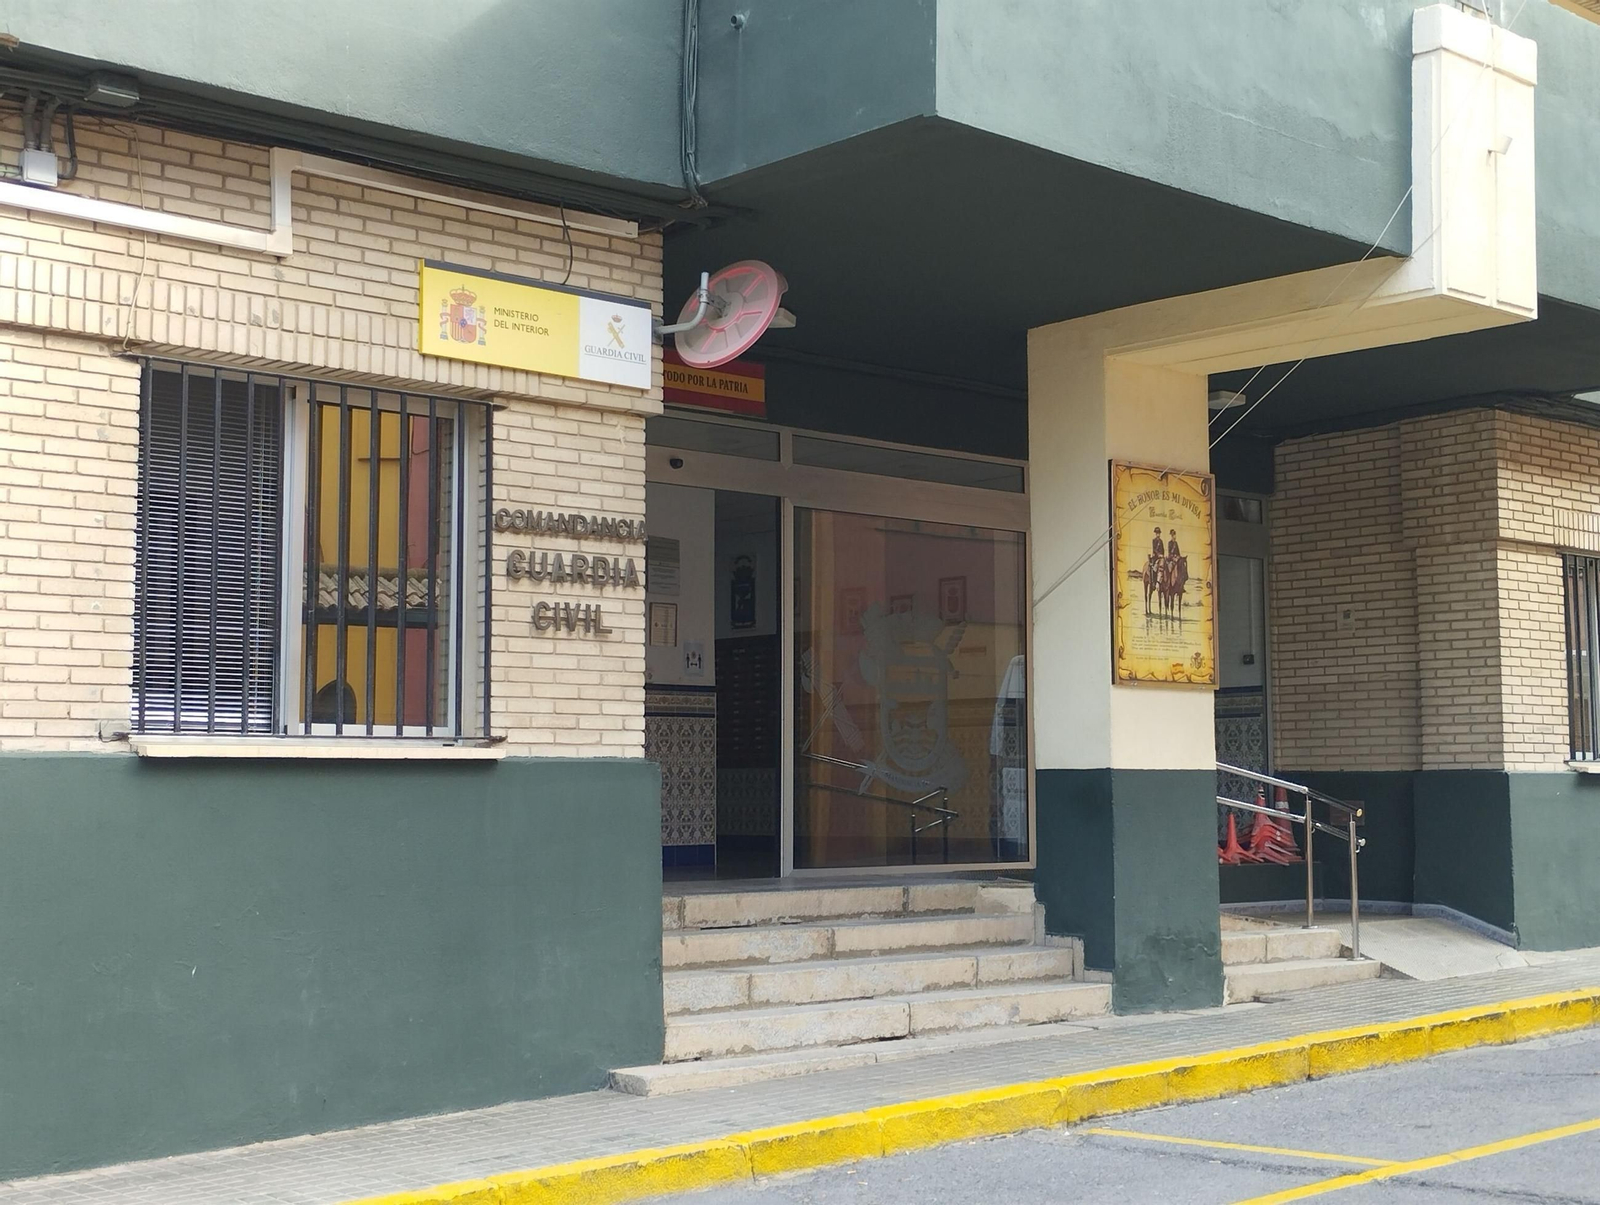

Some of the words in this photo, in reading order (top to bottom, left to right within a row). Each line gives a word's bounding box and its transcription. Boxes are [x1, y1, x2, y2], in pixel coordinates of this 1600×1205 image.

[494, 307, 539, 322] MINISTERIO
[494, 319, 509, 330] DEL
[511, 322, 550, 336] INTERIOR
[584, 345, 622, 358] GUARDIA
[624, 351, 646, 363] CIVIL
[687, 374, 705, 387] POR
[706, 377, 717, 388] LA
[719, 379, 749, 394] PATRIA
[1128, 499, 1138, 511] EL
[1162, 490, 1170, 501] ES
[1171, 492, 1180, 504] MI
[1182, 496, 1202, 519] DIVISA
[495, 508, 648, 540] COMANDANCIA
[508, 549, 641, 587] GUARDIA
[533, 601, 613, 634] CIVIL
